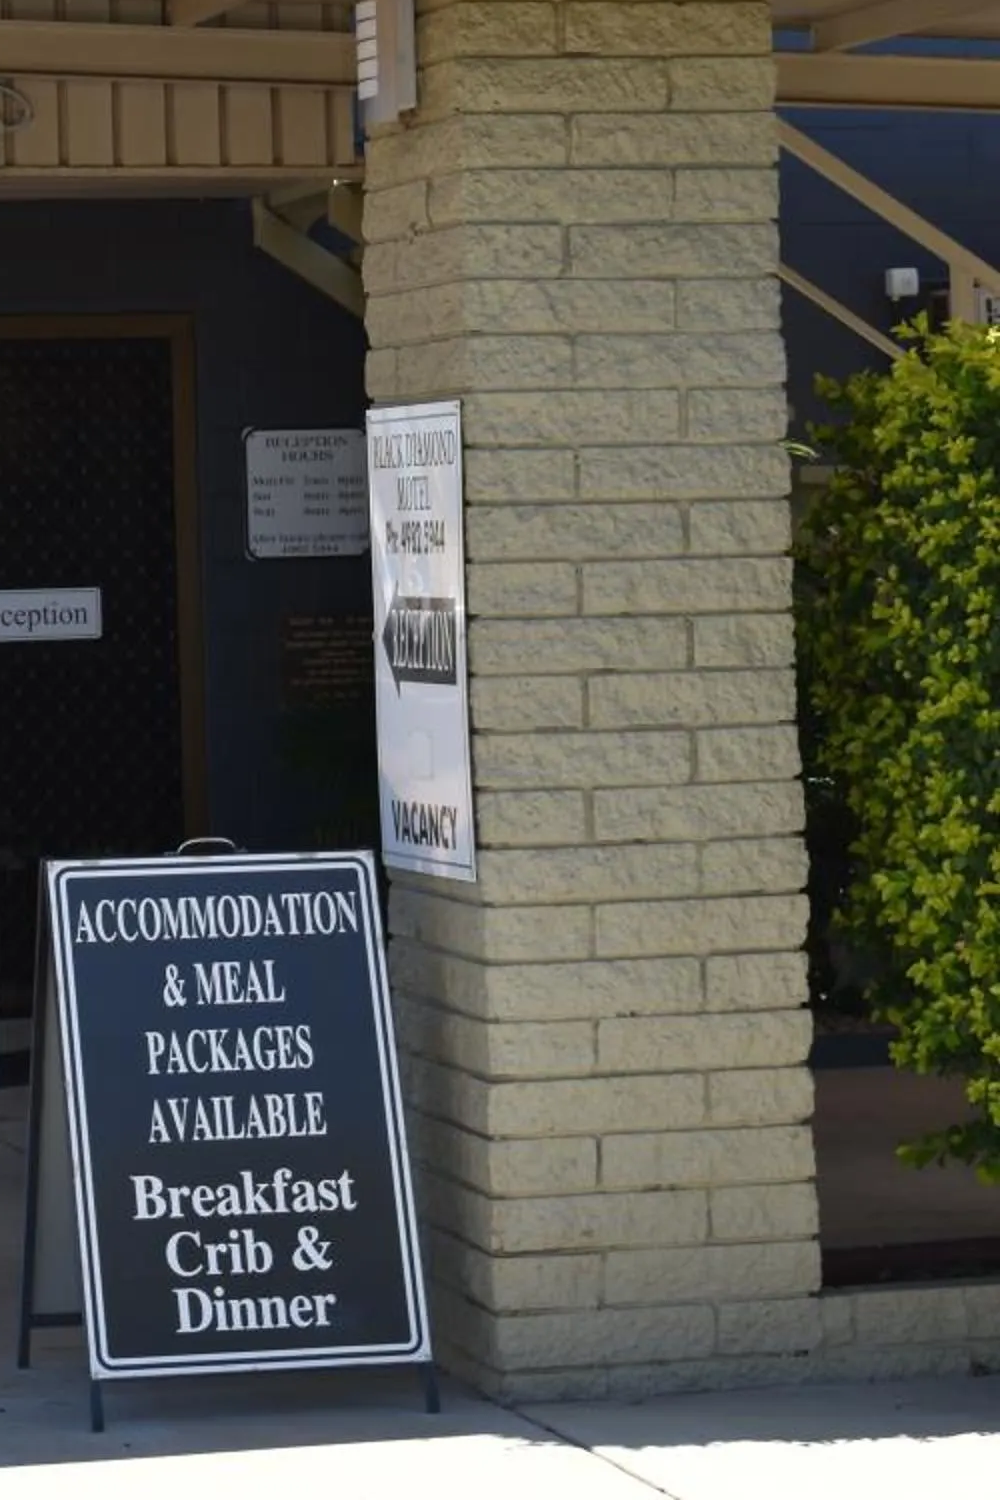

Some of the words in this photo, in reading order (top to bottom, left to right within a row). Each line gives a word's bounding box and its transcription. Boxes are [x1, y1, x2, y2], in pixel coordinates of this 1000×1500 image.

[396, 475, 432, 511] MOTEL
[391, 800, 458, 850] VACANCY
[76, 891, 359, 943] ACCOMMODATION
[163, 963, 187, 1007] &
[194, 959, 286, 1005] MEAL
[145, 1024, 314, 1075] PACKAGES
[148, 1091, 328, 1143] AVAILABLE
[130, 1167, 357, 1220] Breakfast
[166, 1228, 273, 1277] Crib
[291, 1225, 333, 1272] &
[172, 1285, 336, 1333] Dinner
